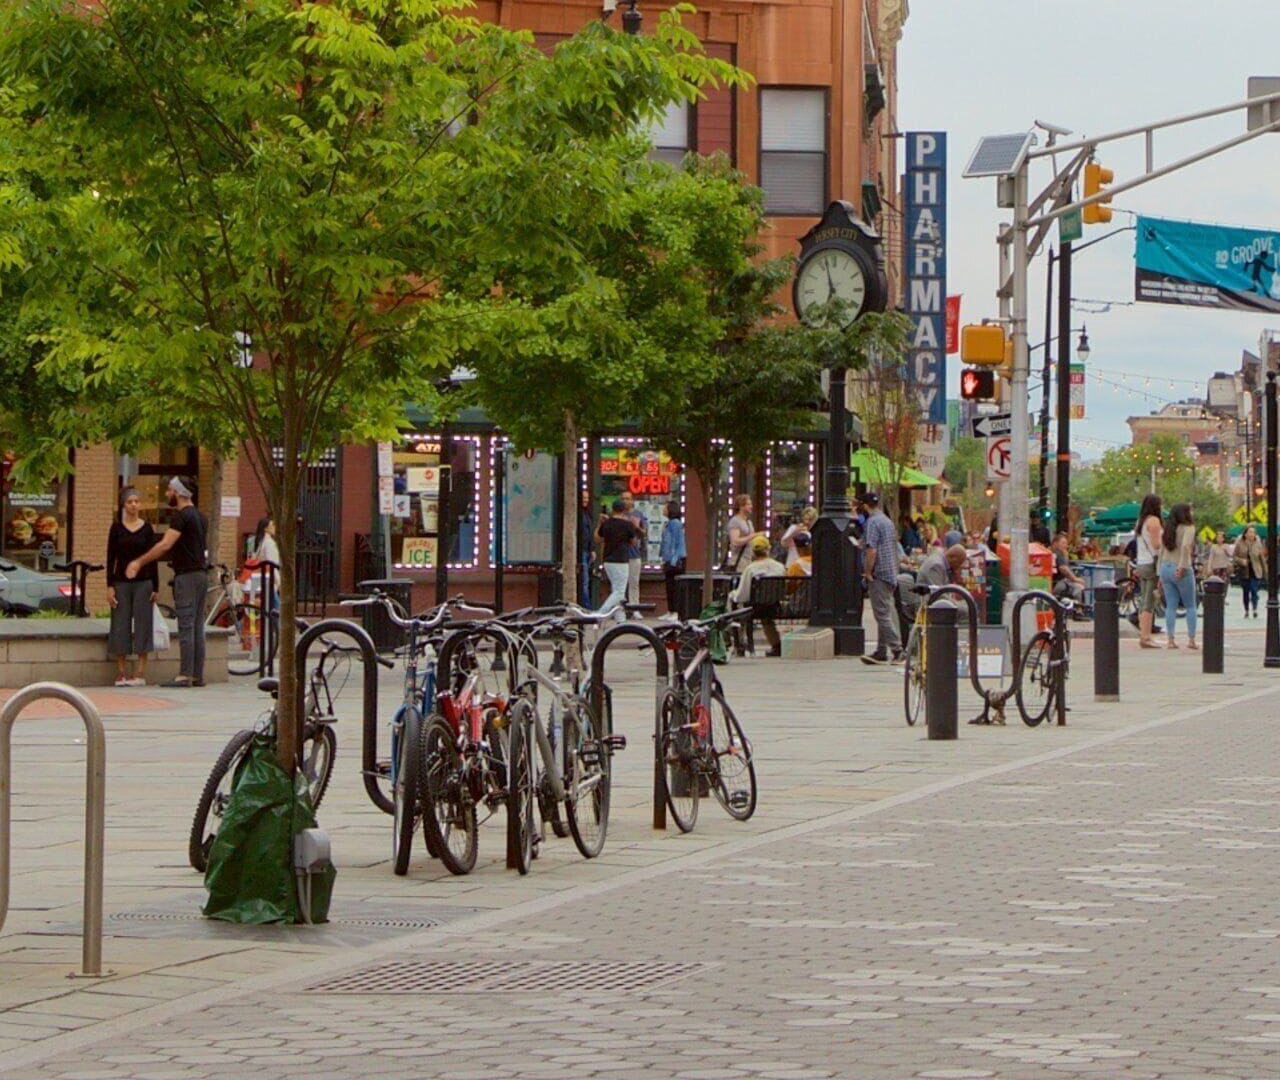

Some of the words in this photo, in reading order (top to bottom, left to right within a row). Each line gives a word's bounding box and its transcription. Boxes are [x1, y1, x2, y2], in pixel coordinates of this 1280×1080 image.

[1231, 236, 1275, 264] GROOVE
[910, 134, 942, 419] PHARMACY
[629, 473, 669, 494] OPEN
[409, 549, 431, 563] ICE
